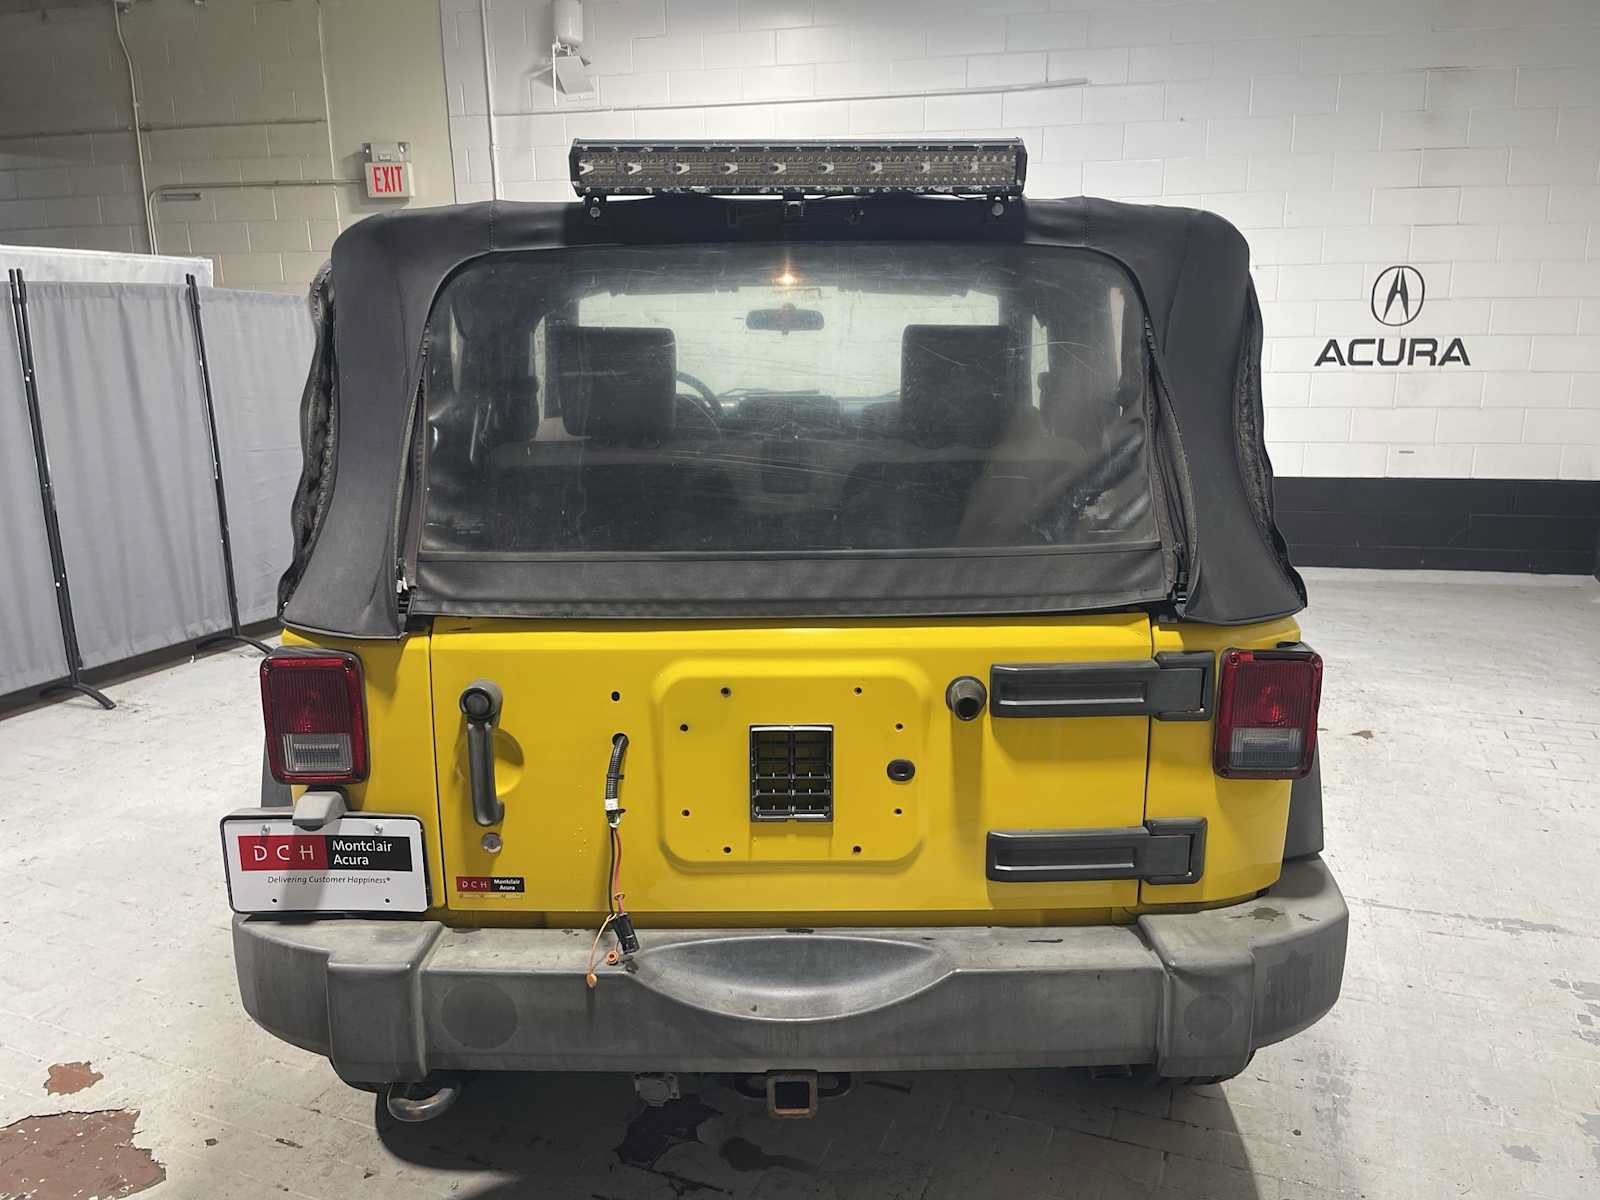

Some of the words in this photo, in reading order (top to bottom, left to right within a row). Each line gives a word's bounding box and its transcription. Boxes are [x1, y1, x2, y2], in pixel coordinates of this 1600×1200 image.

[373, 166, 402, 193] EXIT
[1314, 338, 1471, 366] ACURA
[332, 840, 393, 852] Montclair
[333, 854, 369, 866] Acura
[267, 876, 307, 885] Delivering
[308, 876, 347, 884] Customer
